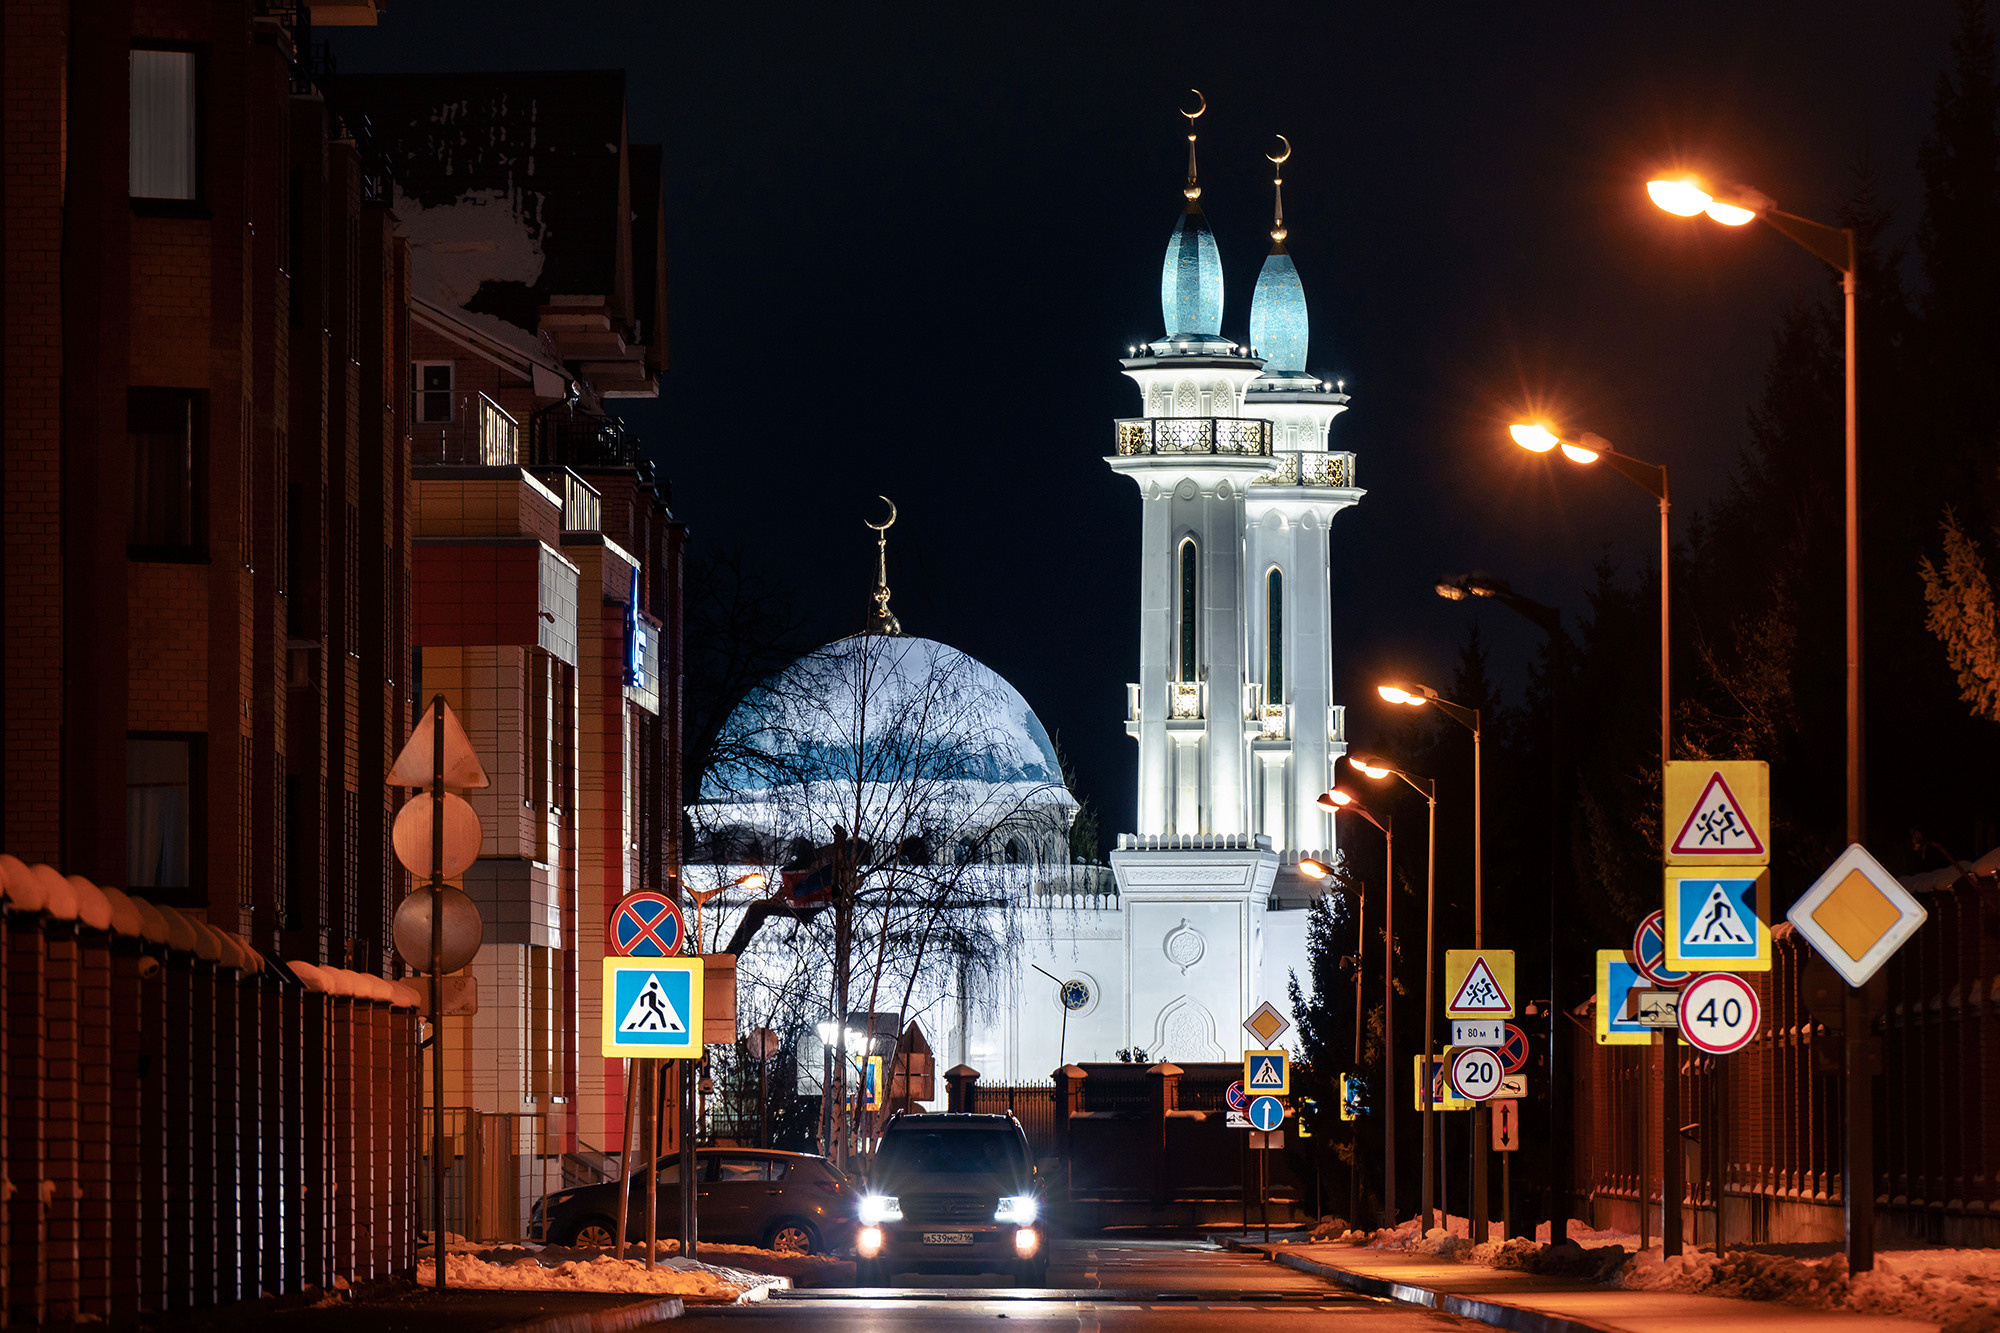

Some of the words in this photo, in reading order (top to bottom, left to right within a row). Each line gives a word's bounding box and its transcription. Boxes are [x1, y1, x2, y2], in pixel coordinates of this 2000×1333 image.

[1696, 998, 1741, 1027] 40
[1467, 1028, 1478, 1038] 80
[1465, 1062, 1493, 1083] 20
